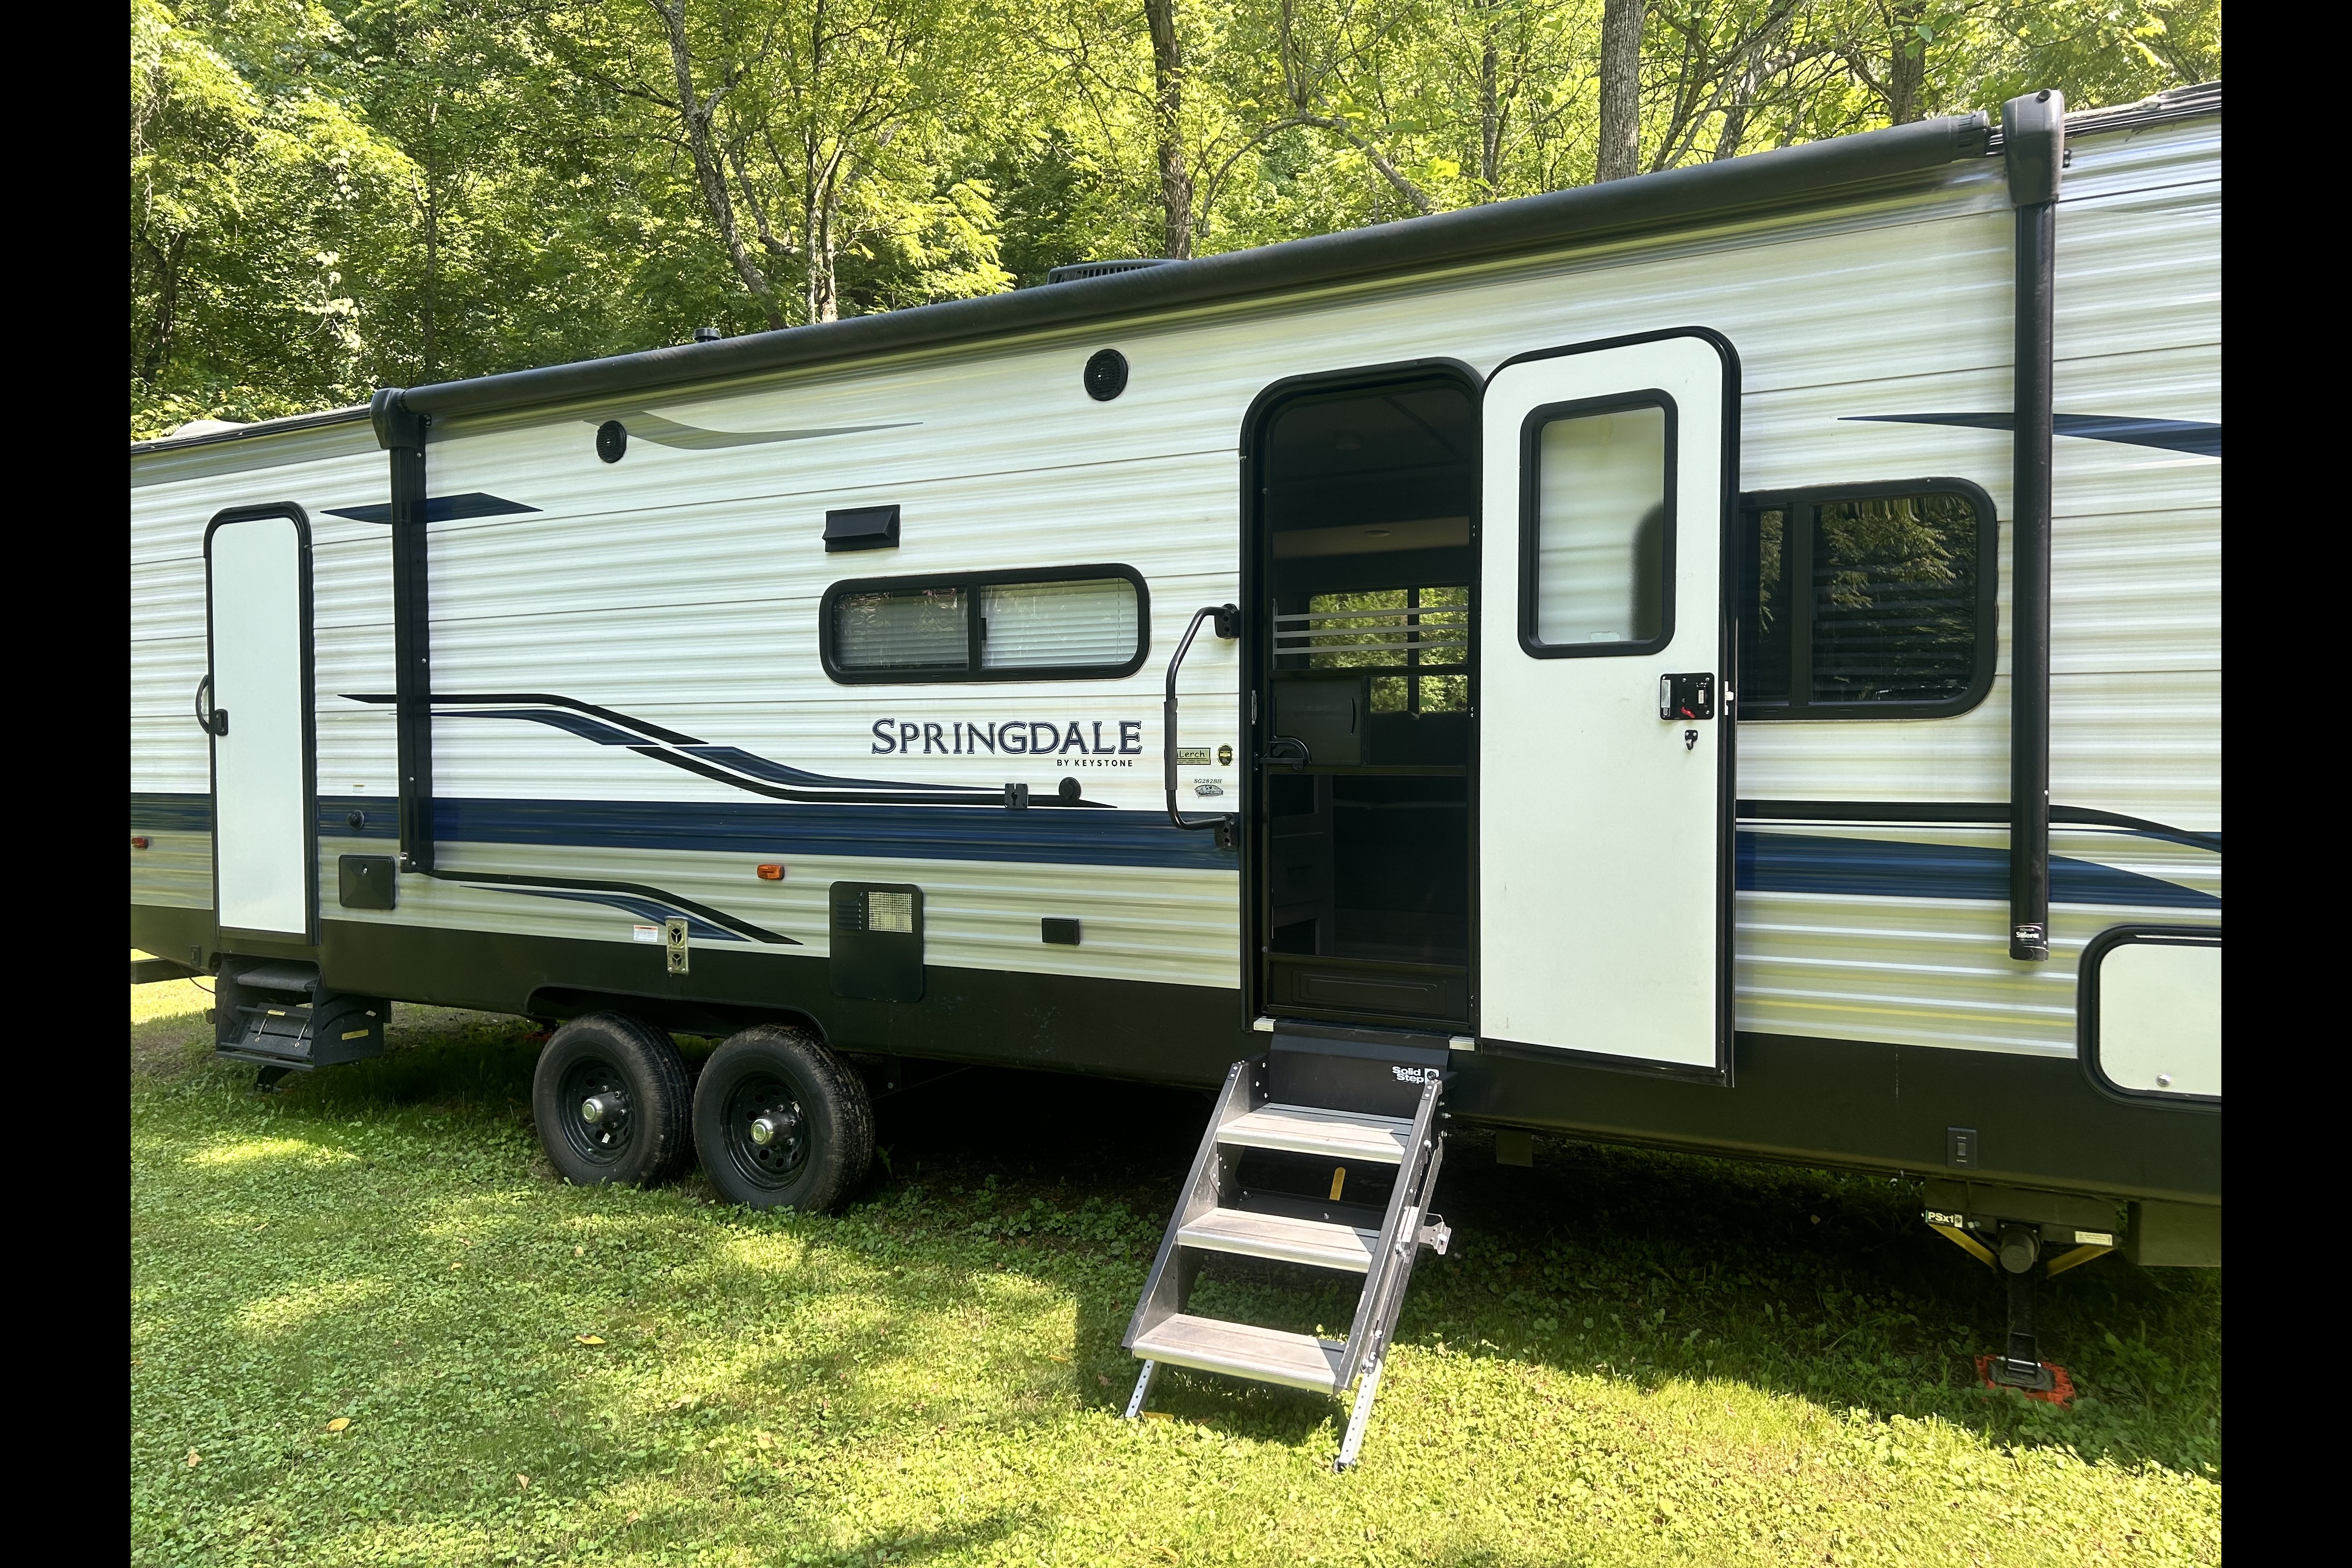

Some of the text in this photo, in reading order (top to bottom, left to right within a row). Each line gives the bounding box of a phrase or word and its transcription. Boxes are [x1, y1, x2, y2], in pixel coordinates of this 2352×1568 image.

[872, 718, 1142, 754] SPRINGDALE
[1392, 1066, 1421, 1076] Solid
[1396, 1073, 1424, 1084] Step
[1928, 1211, 1954, 1223] PSx1
